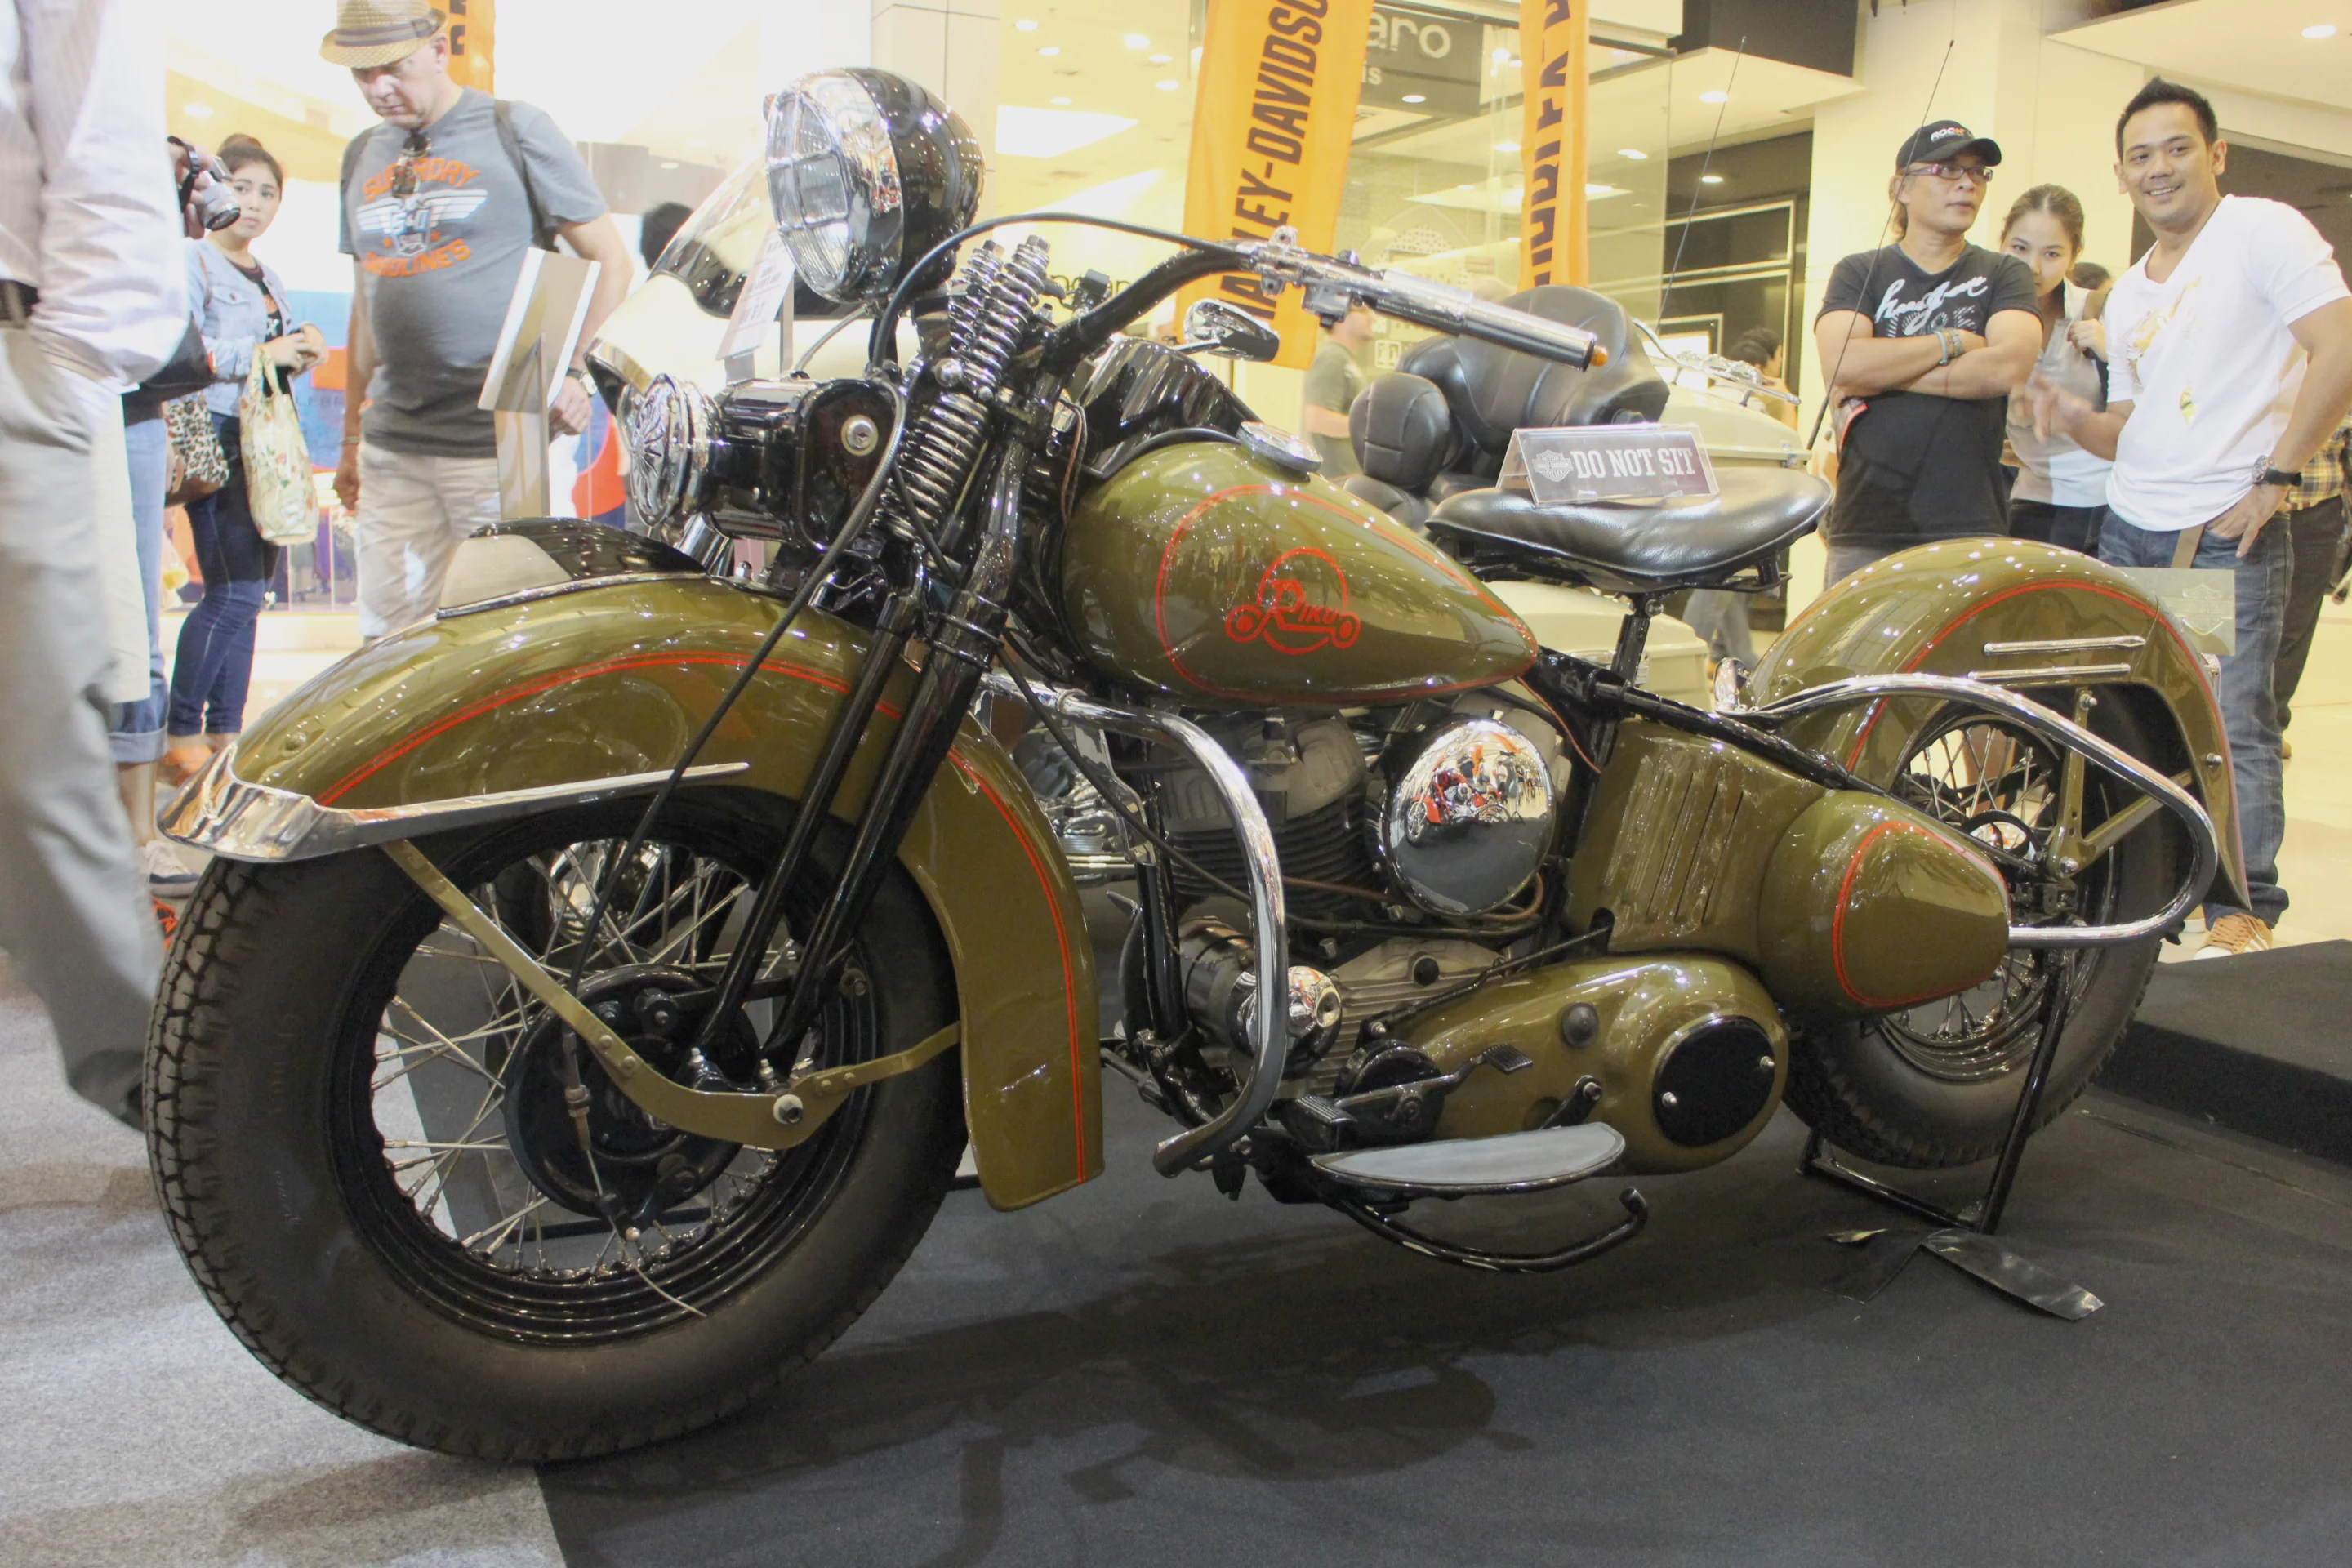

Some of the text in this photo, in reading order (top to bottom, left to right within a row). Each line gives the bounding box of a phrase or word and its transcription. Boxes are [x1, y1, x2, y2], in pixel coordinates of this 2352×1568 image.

[1219, 0, 1328, 321] ALEY-DAVIDS
[1570, 447, 1695, 479] DO NOT SIT
